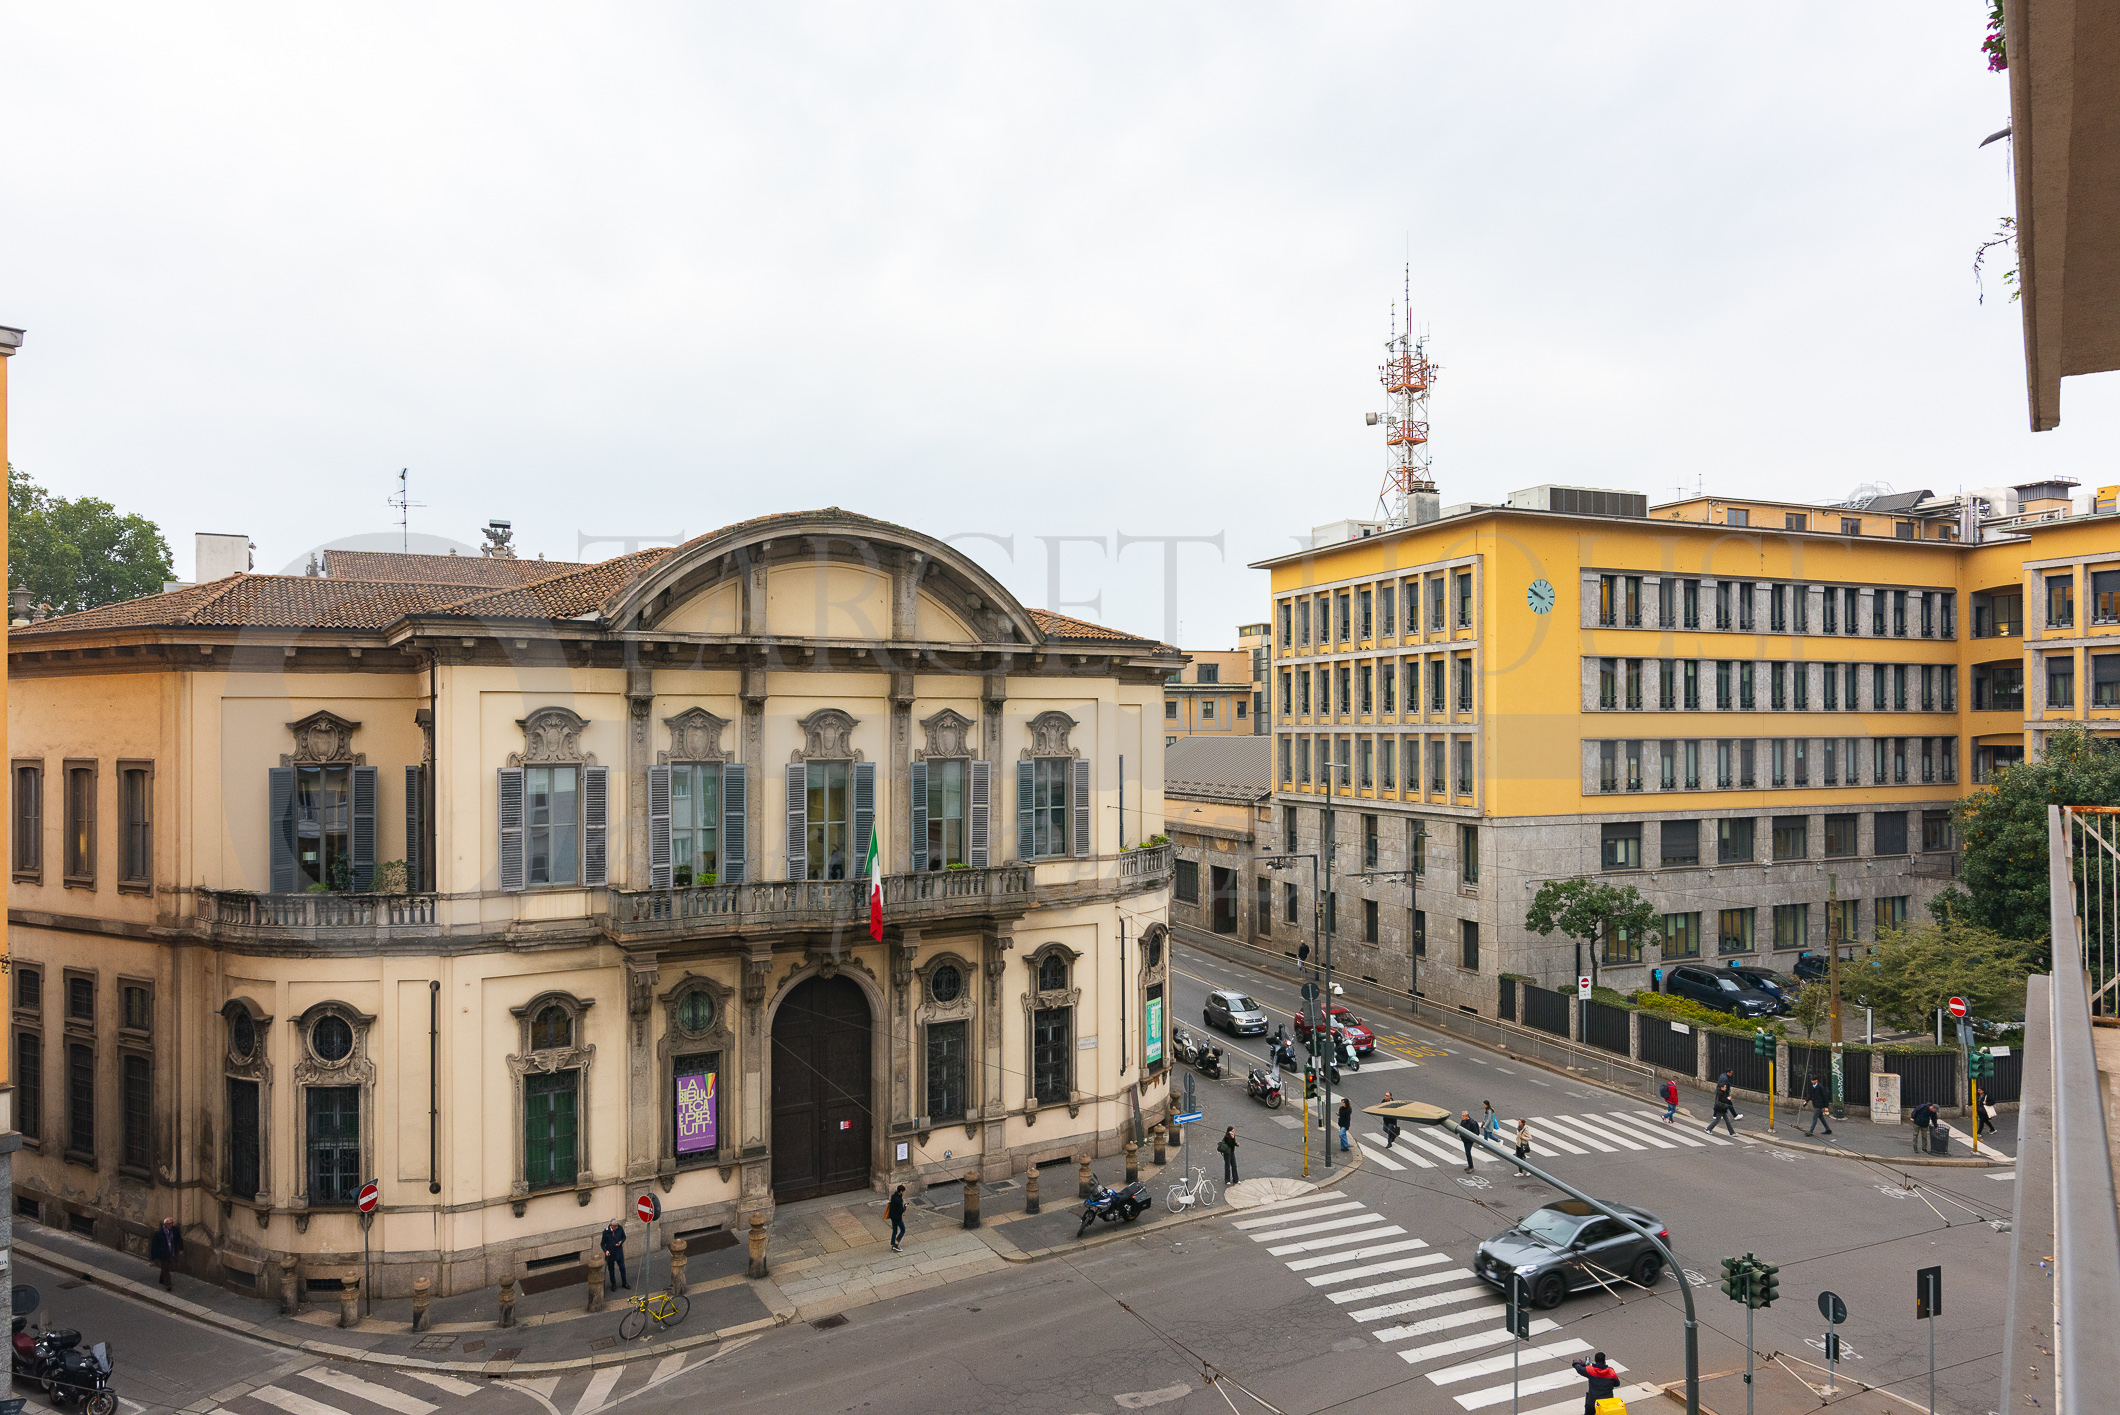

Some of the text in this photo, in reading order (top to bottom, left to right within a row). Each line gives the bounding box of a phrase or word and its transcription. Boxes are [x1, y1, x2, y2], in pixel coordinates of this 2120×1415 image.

[679, 1079, 698, 1091] LA
[679, 1089, 714, 1103] BIBLIO
[679, 1099, 709, 1113] TECA
[685, 1110, 710, 1124] PER
